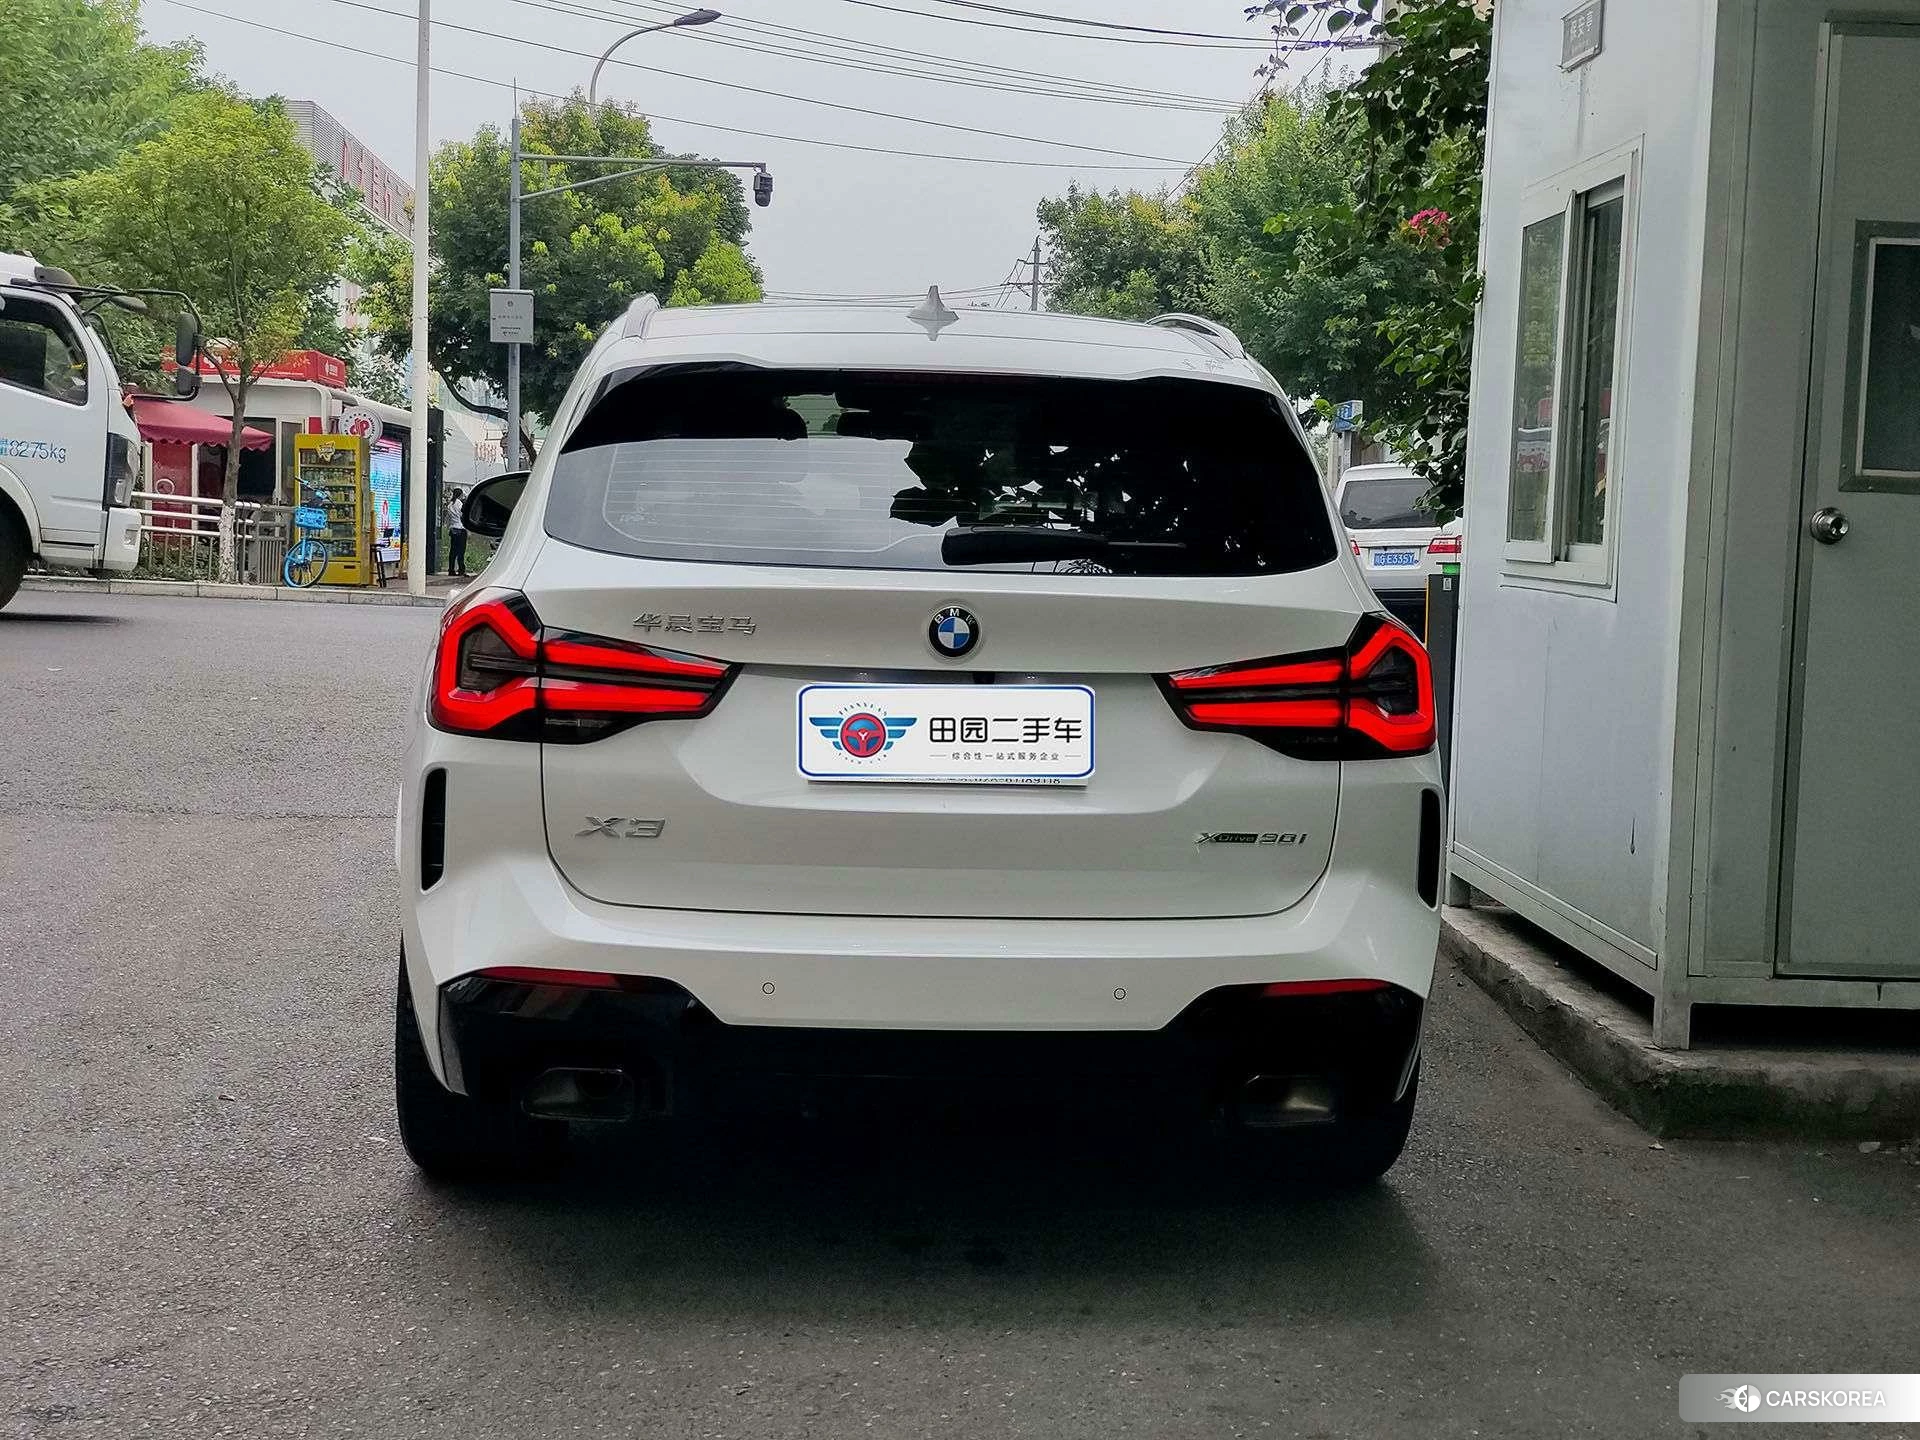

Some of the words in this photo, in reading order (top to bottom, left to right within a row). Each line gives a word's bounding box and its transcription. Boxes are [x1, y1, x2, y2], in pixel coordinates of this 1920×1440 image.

[632, 613, 757, 636] 华晨宝马
[934, 608, 976, 625] BMW
[929, 716, 1082, 743] 田园二手车
[951, 751, 1060, 761] 综合性一站式服务企业
[574, 816, 666, 839] X3
